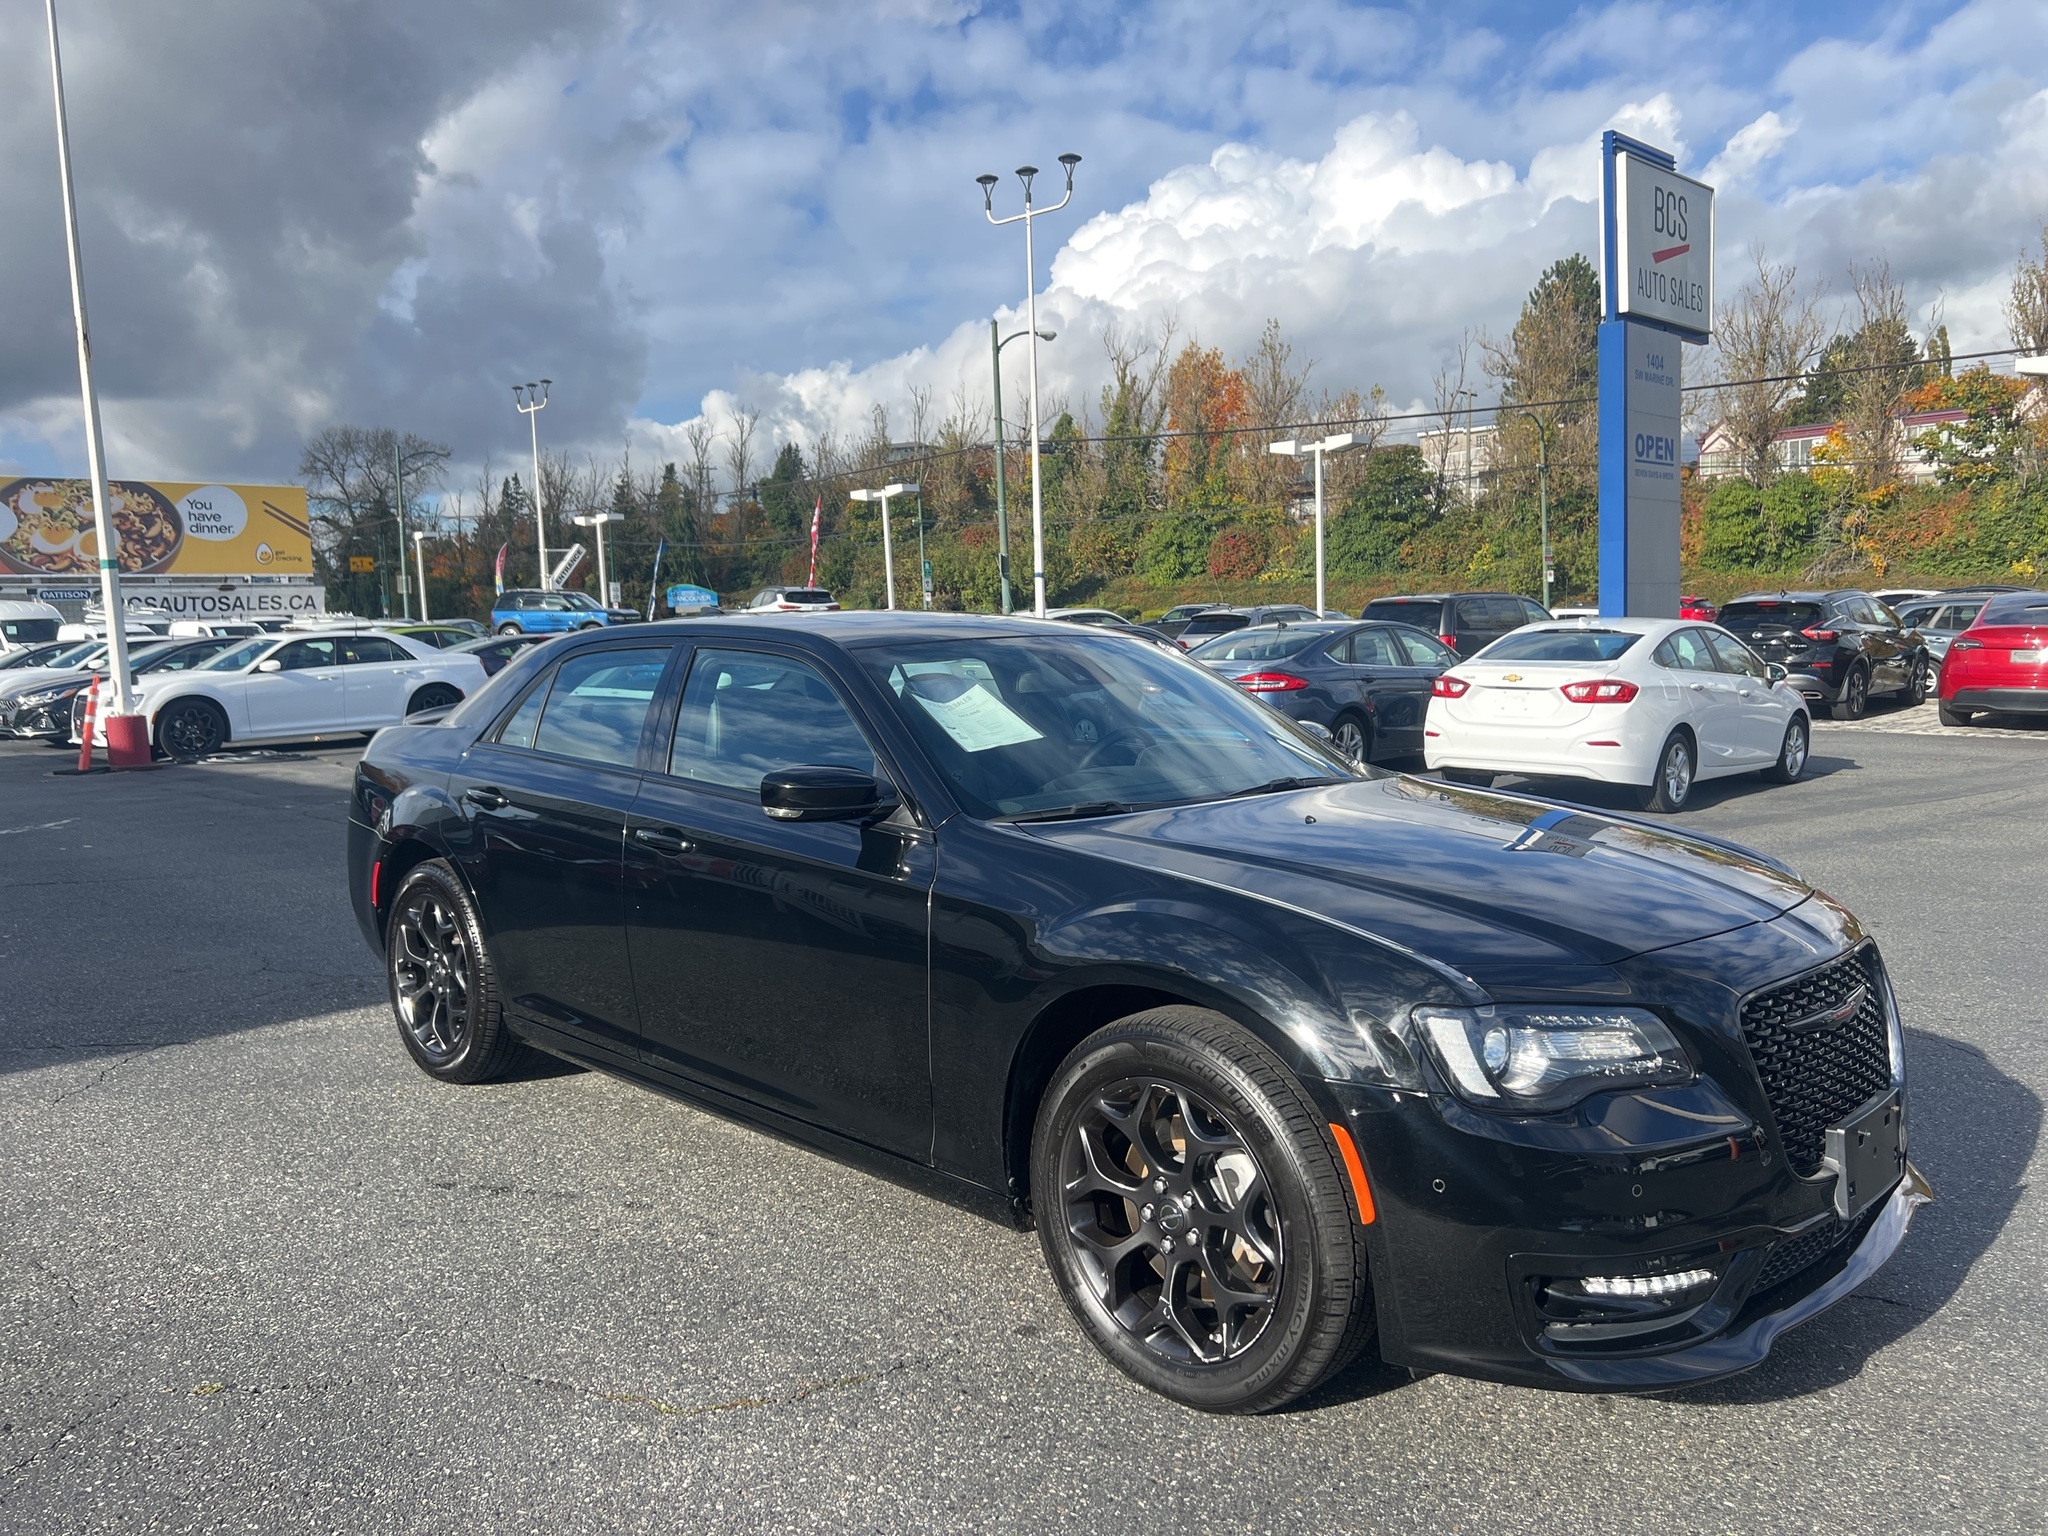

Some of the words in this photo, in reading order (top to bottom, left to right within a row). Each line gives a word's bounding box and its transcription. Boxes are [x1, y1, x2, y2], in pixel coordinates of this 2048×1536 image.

[1654, 185, 1688, 242] BCS
[1637, 267, 1666, 303] AUTO
[1670, 277, 1703, 313] SALES
[1646, 352, 1664, 371] 1404
[1644, 371, 1665, 386] MARINE
[1634, 433, 1674, 462] OPEN
[186, 498, 213, 511] You
[188, 510, 222, 522] have
[189, 522, 235, 534] dinner.
[555, 549, 584, 585] ENTRANCE
[42, 590, 88, 599] PATTISON
[121, 595, 317, 613] CSAUTOSALES.CA
[1166, 1048, 1256, 1117] MICHELIN
